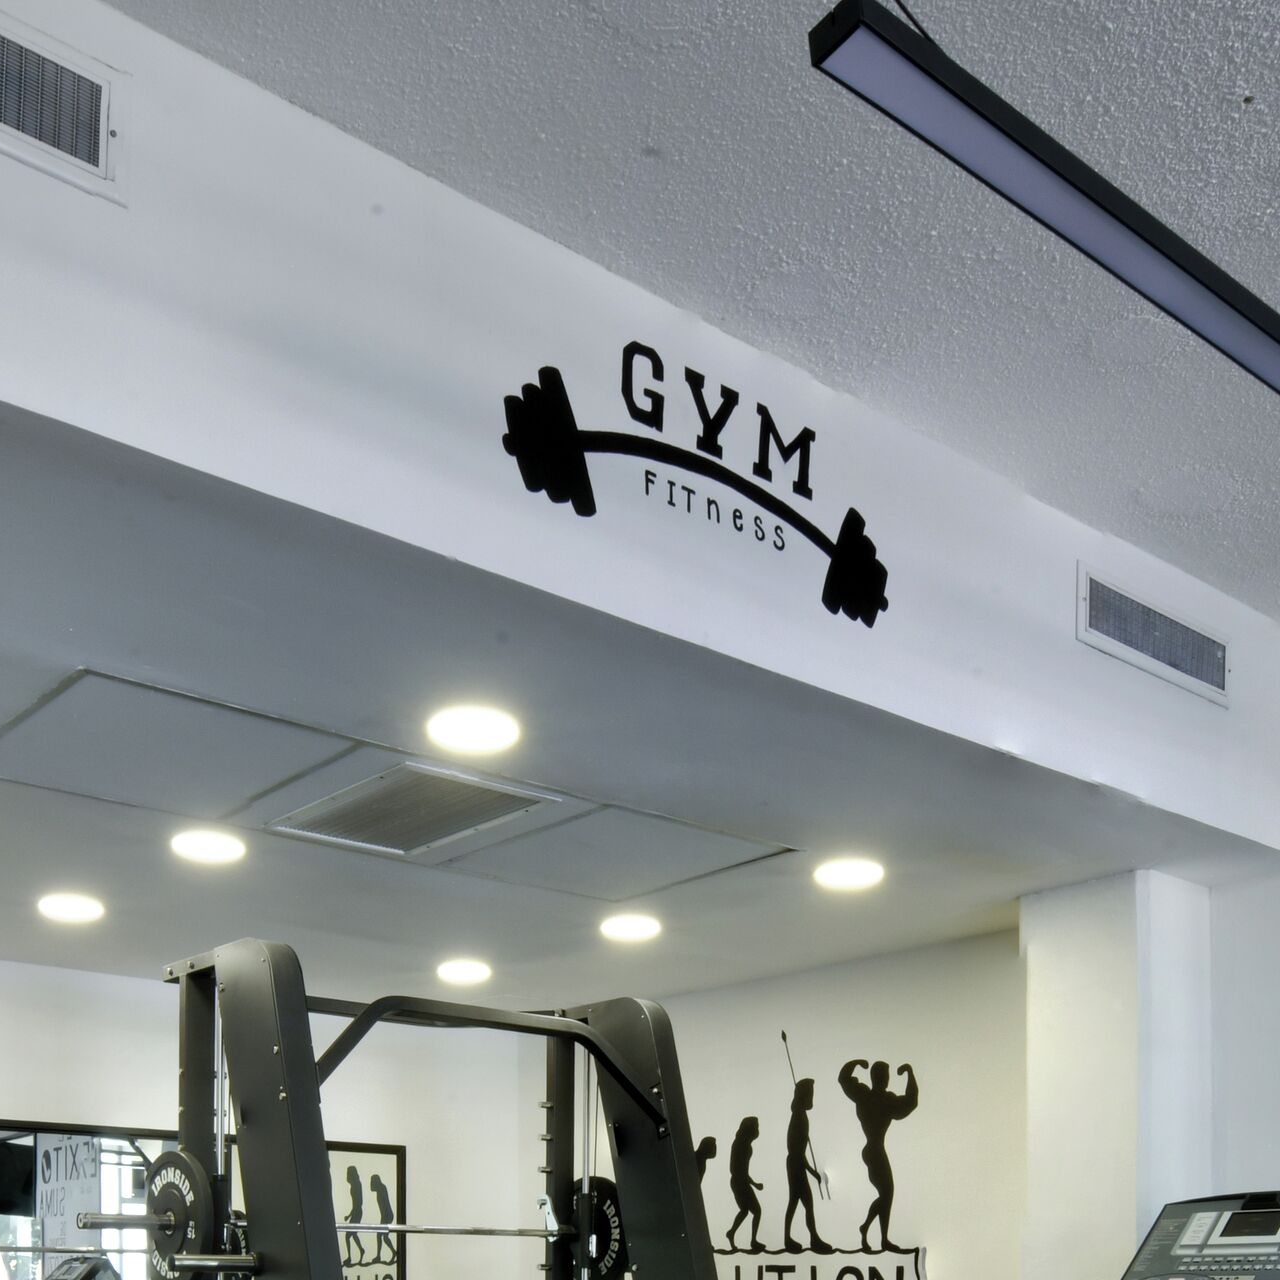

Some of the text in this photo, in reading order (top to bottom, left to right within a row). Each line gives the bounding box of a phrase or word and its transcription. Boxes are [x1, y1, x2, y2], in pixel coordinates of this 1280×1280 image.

[621, 340, 816, 500] GYM
[151, 1167, 195, 1207] IRONSIDE
[598, 1199, 620, 1276] IRONSIDE
